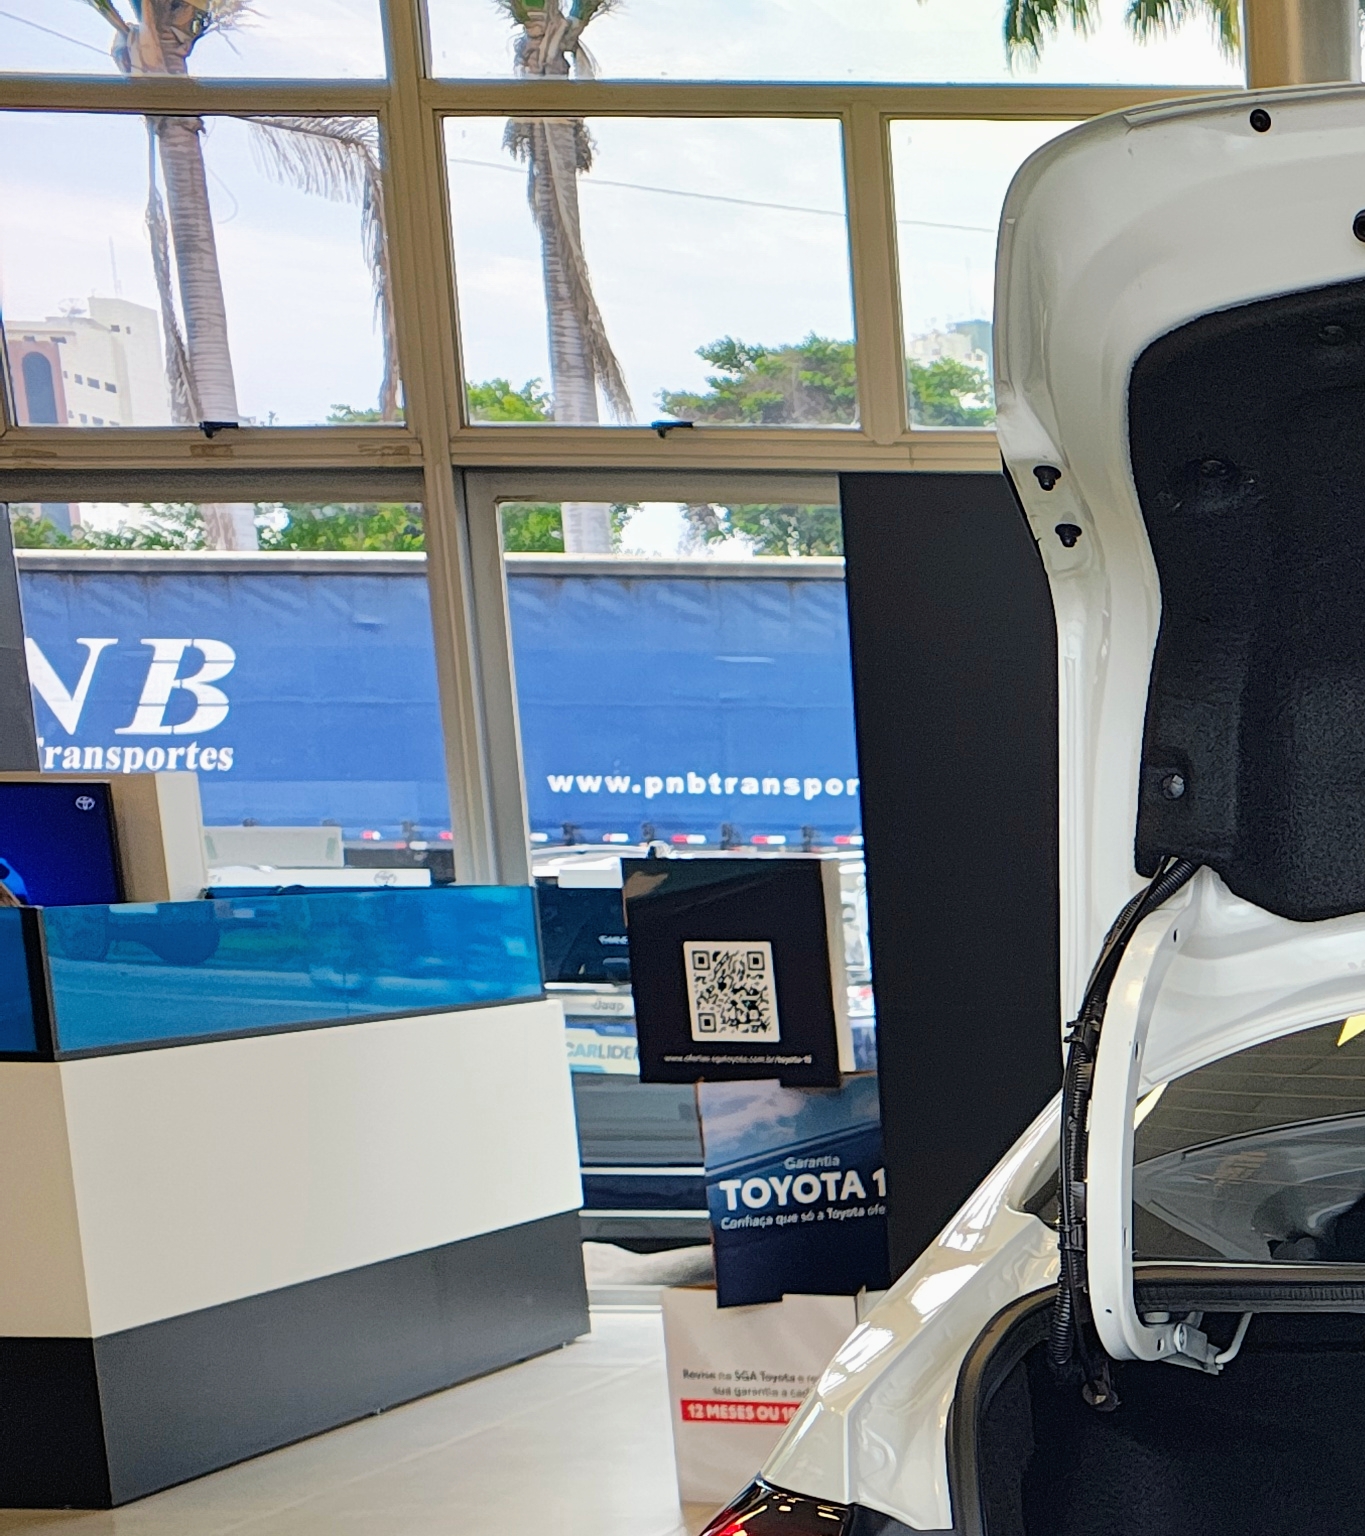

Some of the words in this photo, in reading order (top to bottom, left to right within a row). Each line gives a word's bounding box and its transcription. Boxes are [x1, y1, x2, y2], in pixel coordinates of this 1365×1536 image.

[37, 737, 234, 773] ransportes
[547, 771, 860, 800] www.pnbtranspor
[783, 1155, 840, 1170] Garantia
[719, 1170, 867, 1211] TOYOTA
[775, 1211, 798, 1226] que
[817, 1211, 825, 1221] a
[826, 1206, 865, 1221] Toyota
[760, 1371, 795, 1383] Toyota
[734, 1387, 779, 1398] garantia
[688, 1403, 705, 1419] 12
[706, 1404, 755, 1421] MESES
[756, 1406, 779, 1421] OU
